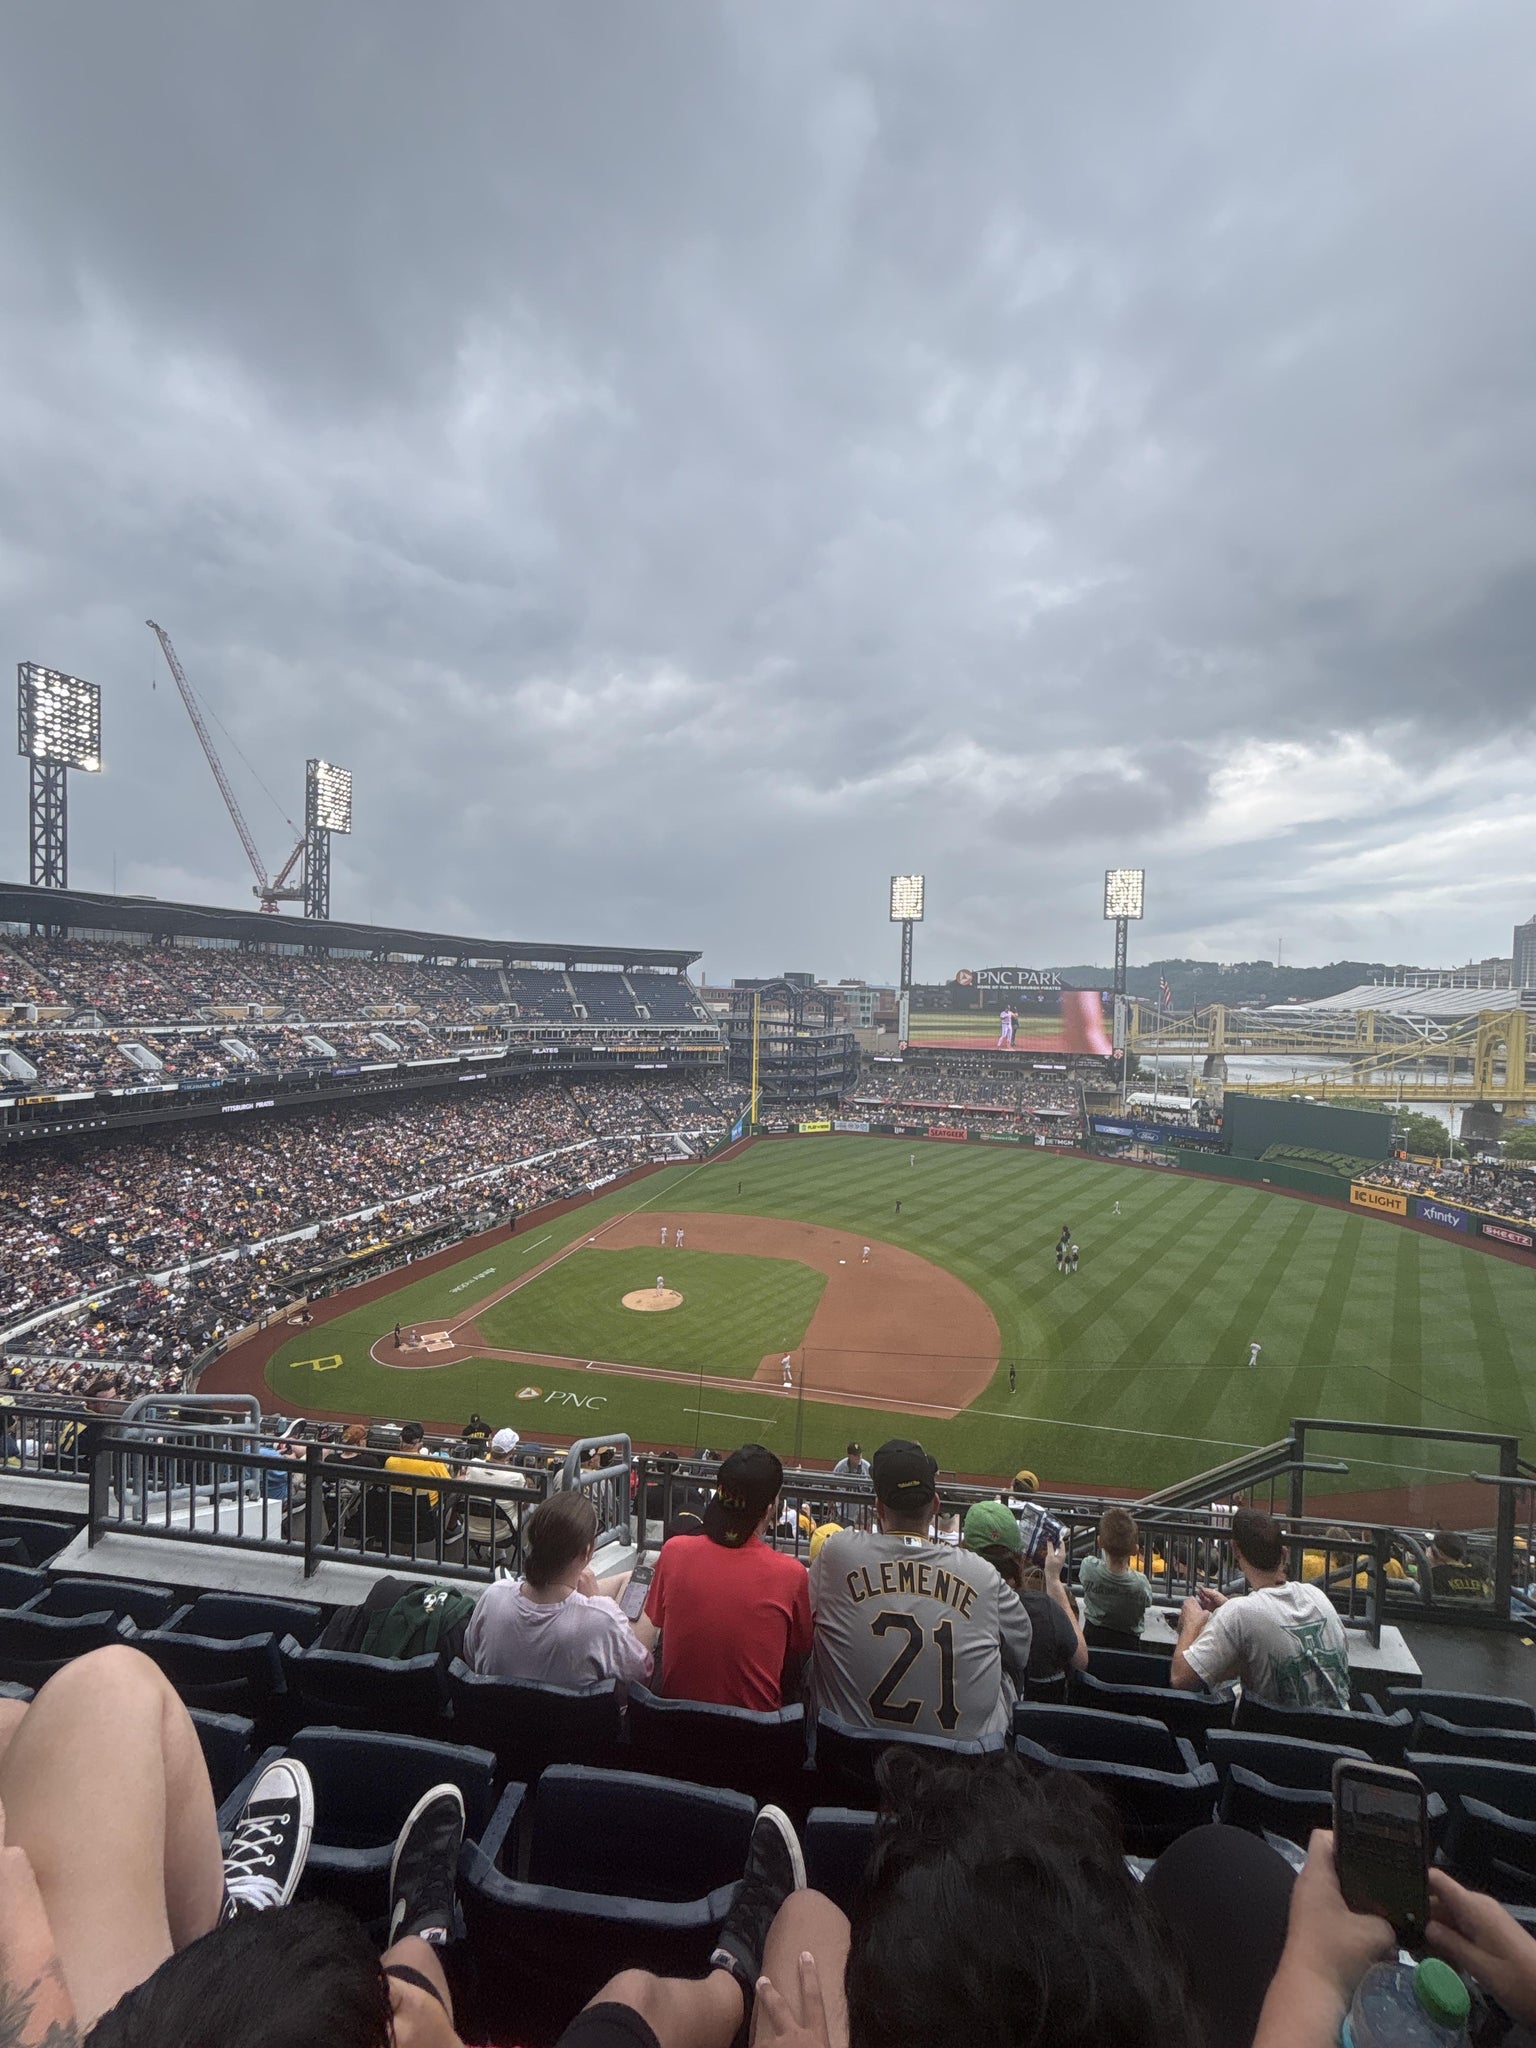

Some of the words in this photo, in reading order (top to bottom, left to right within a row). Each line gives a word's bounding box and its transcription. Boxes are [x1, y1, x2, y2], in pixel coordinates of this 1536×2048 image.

[976, 971, 1012, 985] PNC
[1017, 971, 1062, 985] PARK
[221, 1103, 254, 1113] PITTSBURGH
[930, 1128, 965, 1139] SEATGEEK
[1354, 1190, 1367, 1201] IC
[1368, 1194, 1402, 1209] LIGHT
[1423, 1206, 1460, 1227] xfinity
[1485, 1226, 1529, 1245] SHEETZ
[544, 1390, 608, 1410] PNC
[845, 1559, 979, 1620] CLEMENTE
[866, 1610, 962, 1731] 21
